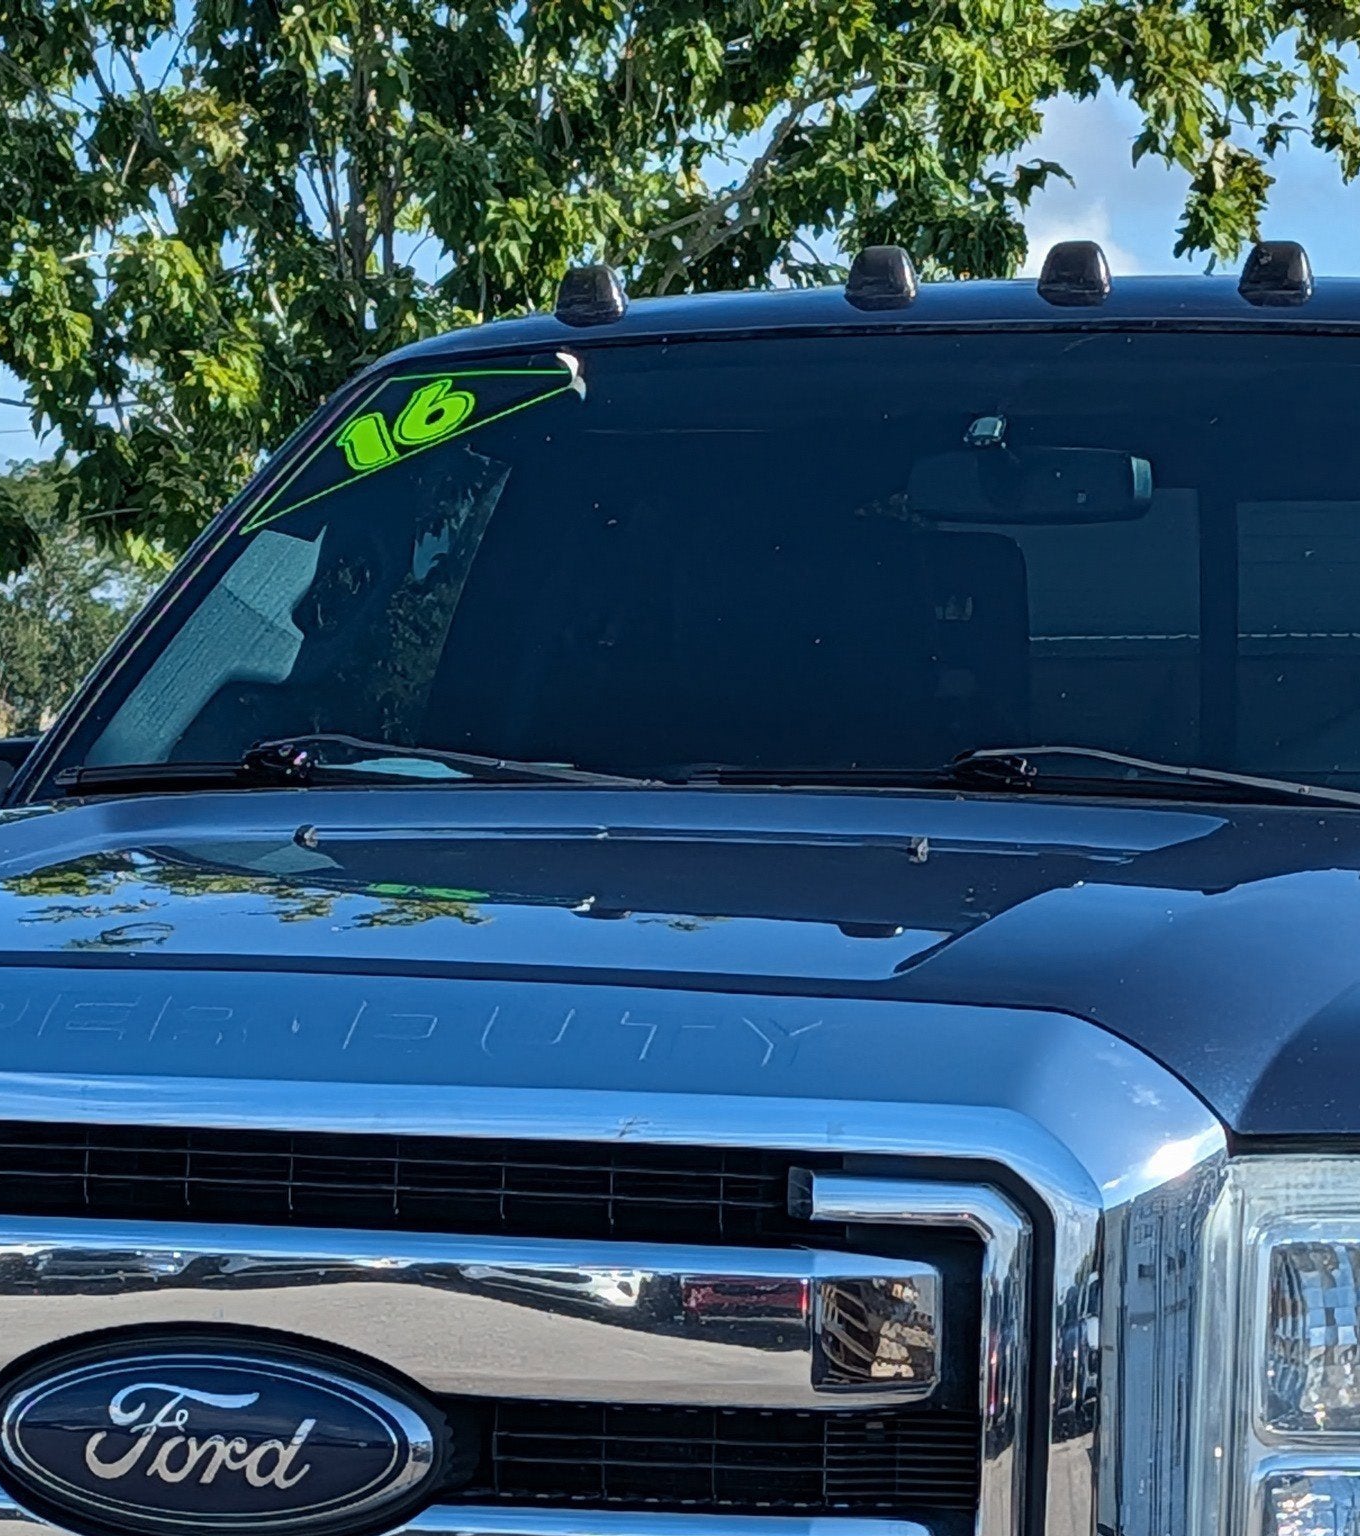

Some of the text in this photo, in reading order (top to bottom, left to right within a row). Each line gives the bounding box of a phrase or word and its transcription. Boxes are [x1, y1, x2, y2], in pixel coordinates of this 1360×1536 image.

[338, 378, 476, 470] 16
[341, 1000, 826, 1066] DUTY
[86, 1383, 316, 1489] Ford
